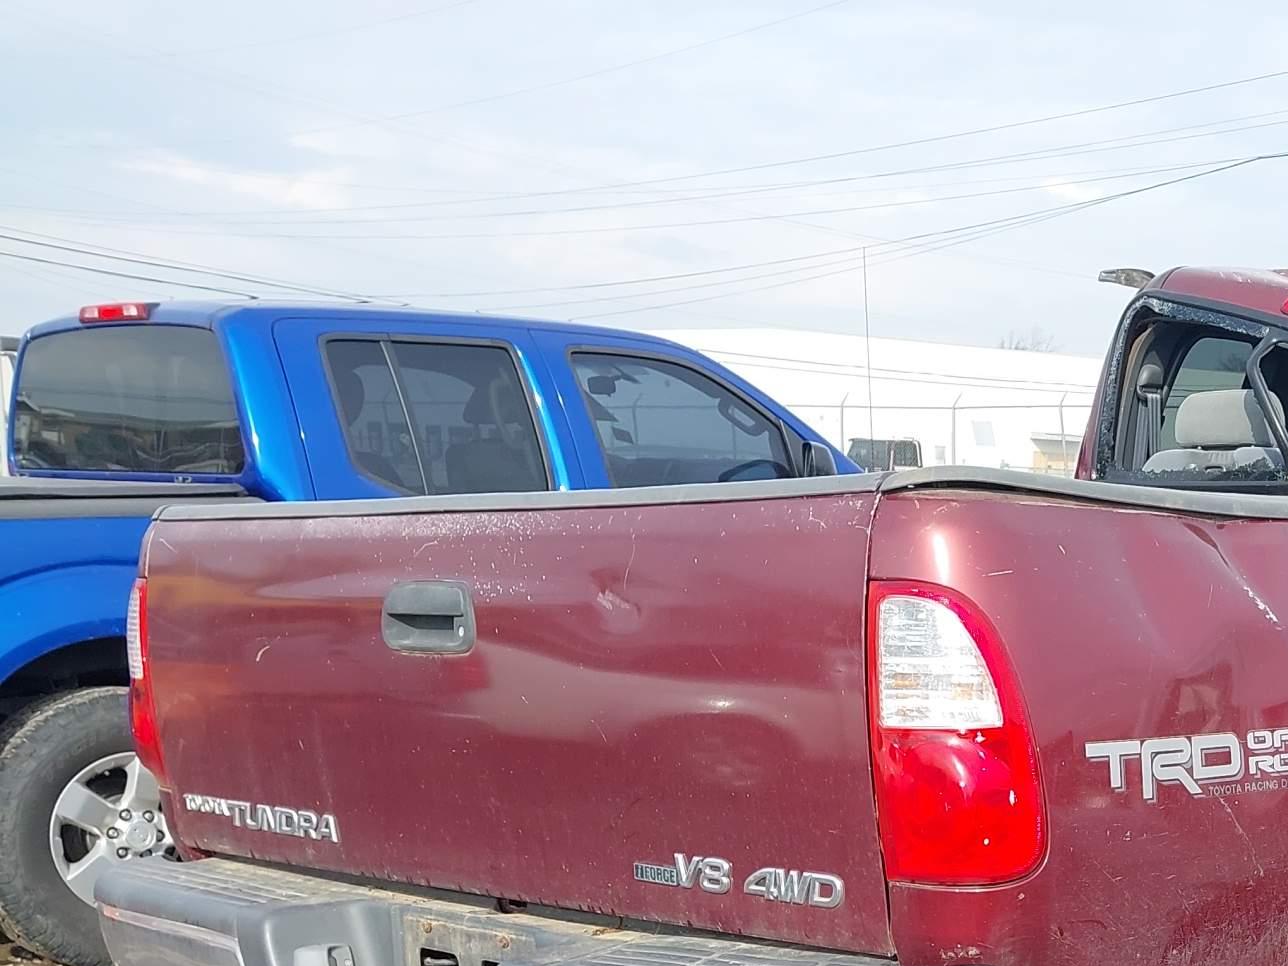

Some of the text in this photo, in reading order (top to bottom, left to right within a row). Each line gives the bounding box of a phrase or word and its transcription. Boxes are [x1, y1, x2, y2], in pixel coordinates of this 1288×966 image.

[1084, 732, 1243, 803] TRD
[1208, 783, 1242, 797] TOYOTA
[1245, 779, 1279, 793] RACING
[227, 800, 340, 844] TUNDRA
[674, 852, 733, 895] V8
[744, 867, 846, 910] 4WD
